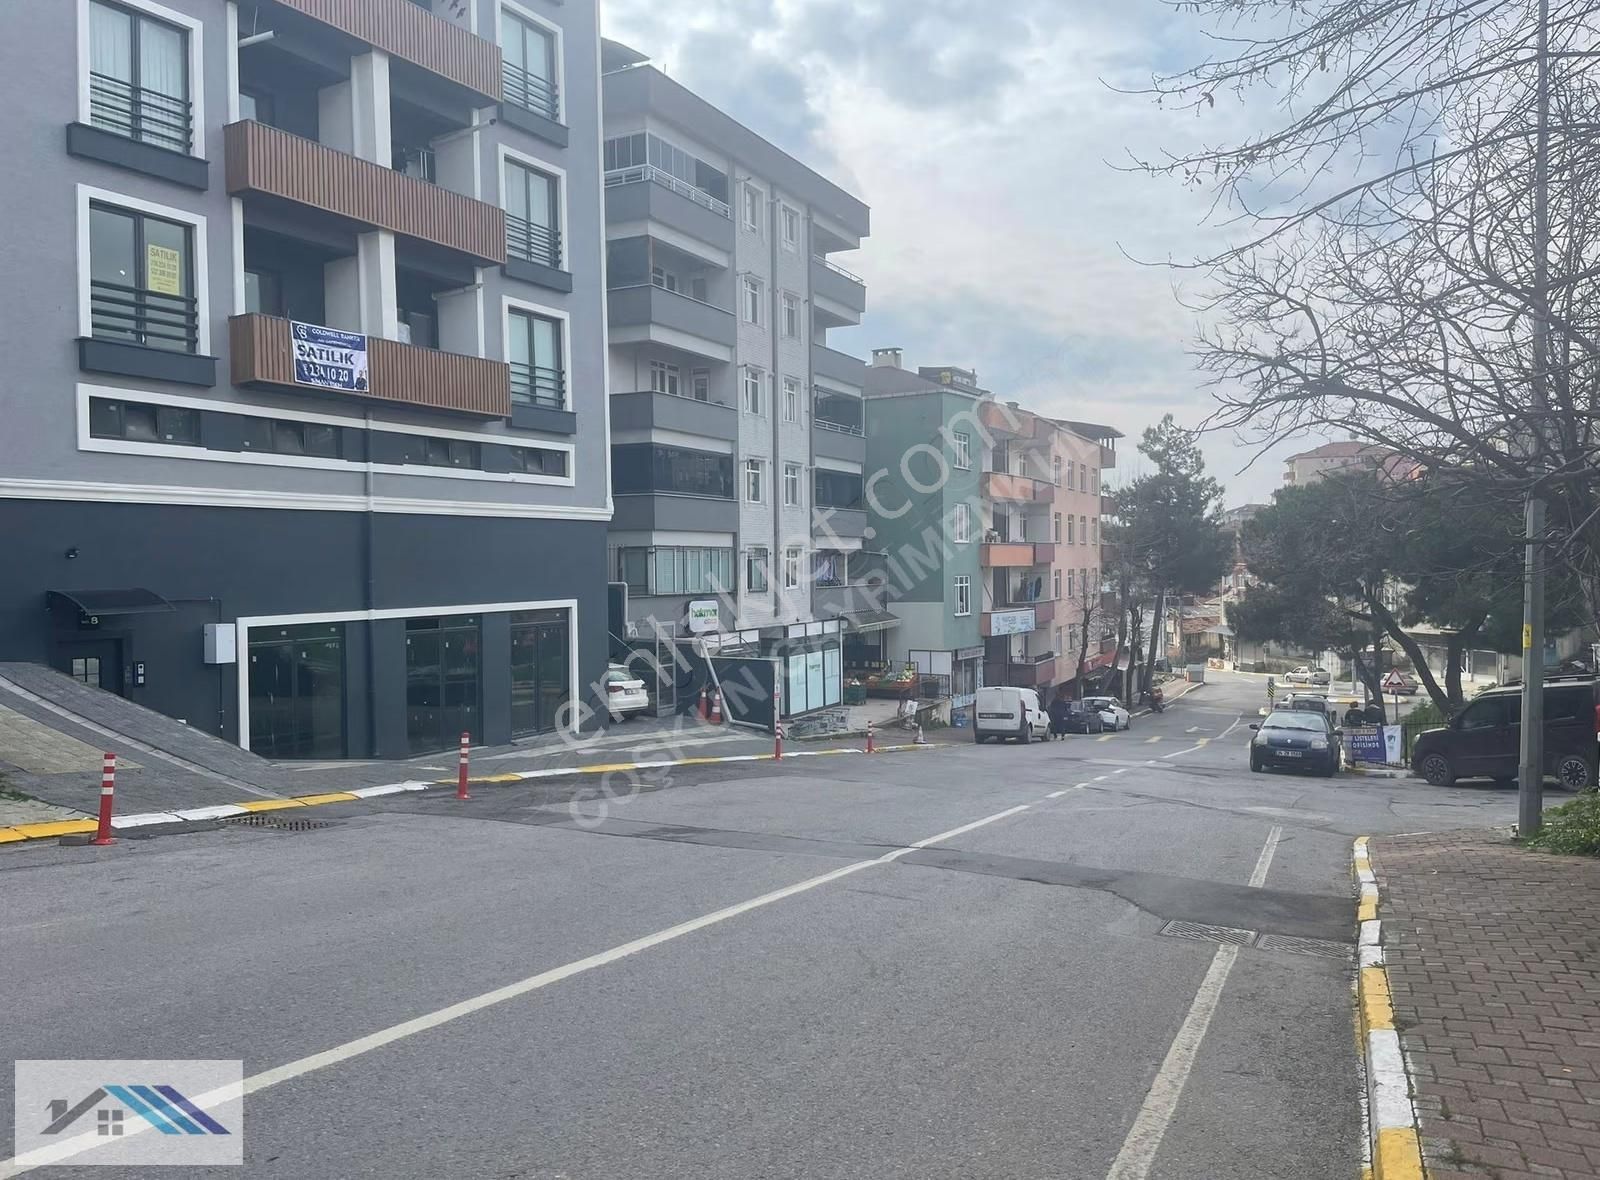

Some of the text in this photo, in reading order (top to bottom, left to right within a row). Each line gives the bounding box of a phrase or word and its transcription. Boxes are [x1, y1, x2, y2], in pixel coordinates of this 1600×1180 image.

[297, 344, 355, 366] SATILIK
[327, 368, 337, 380] 10
[338, 370, 349, 382] 20
